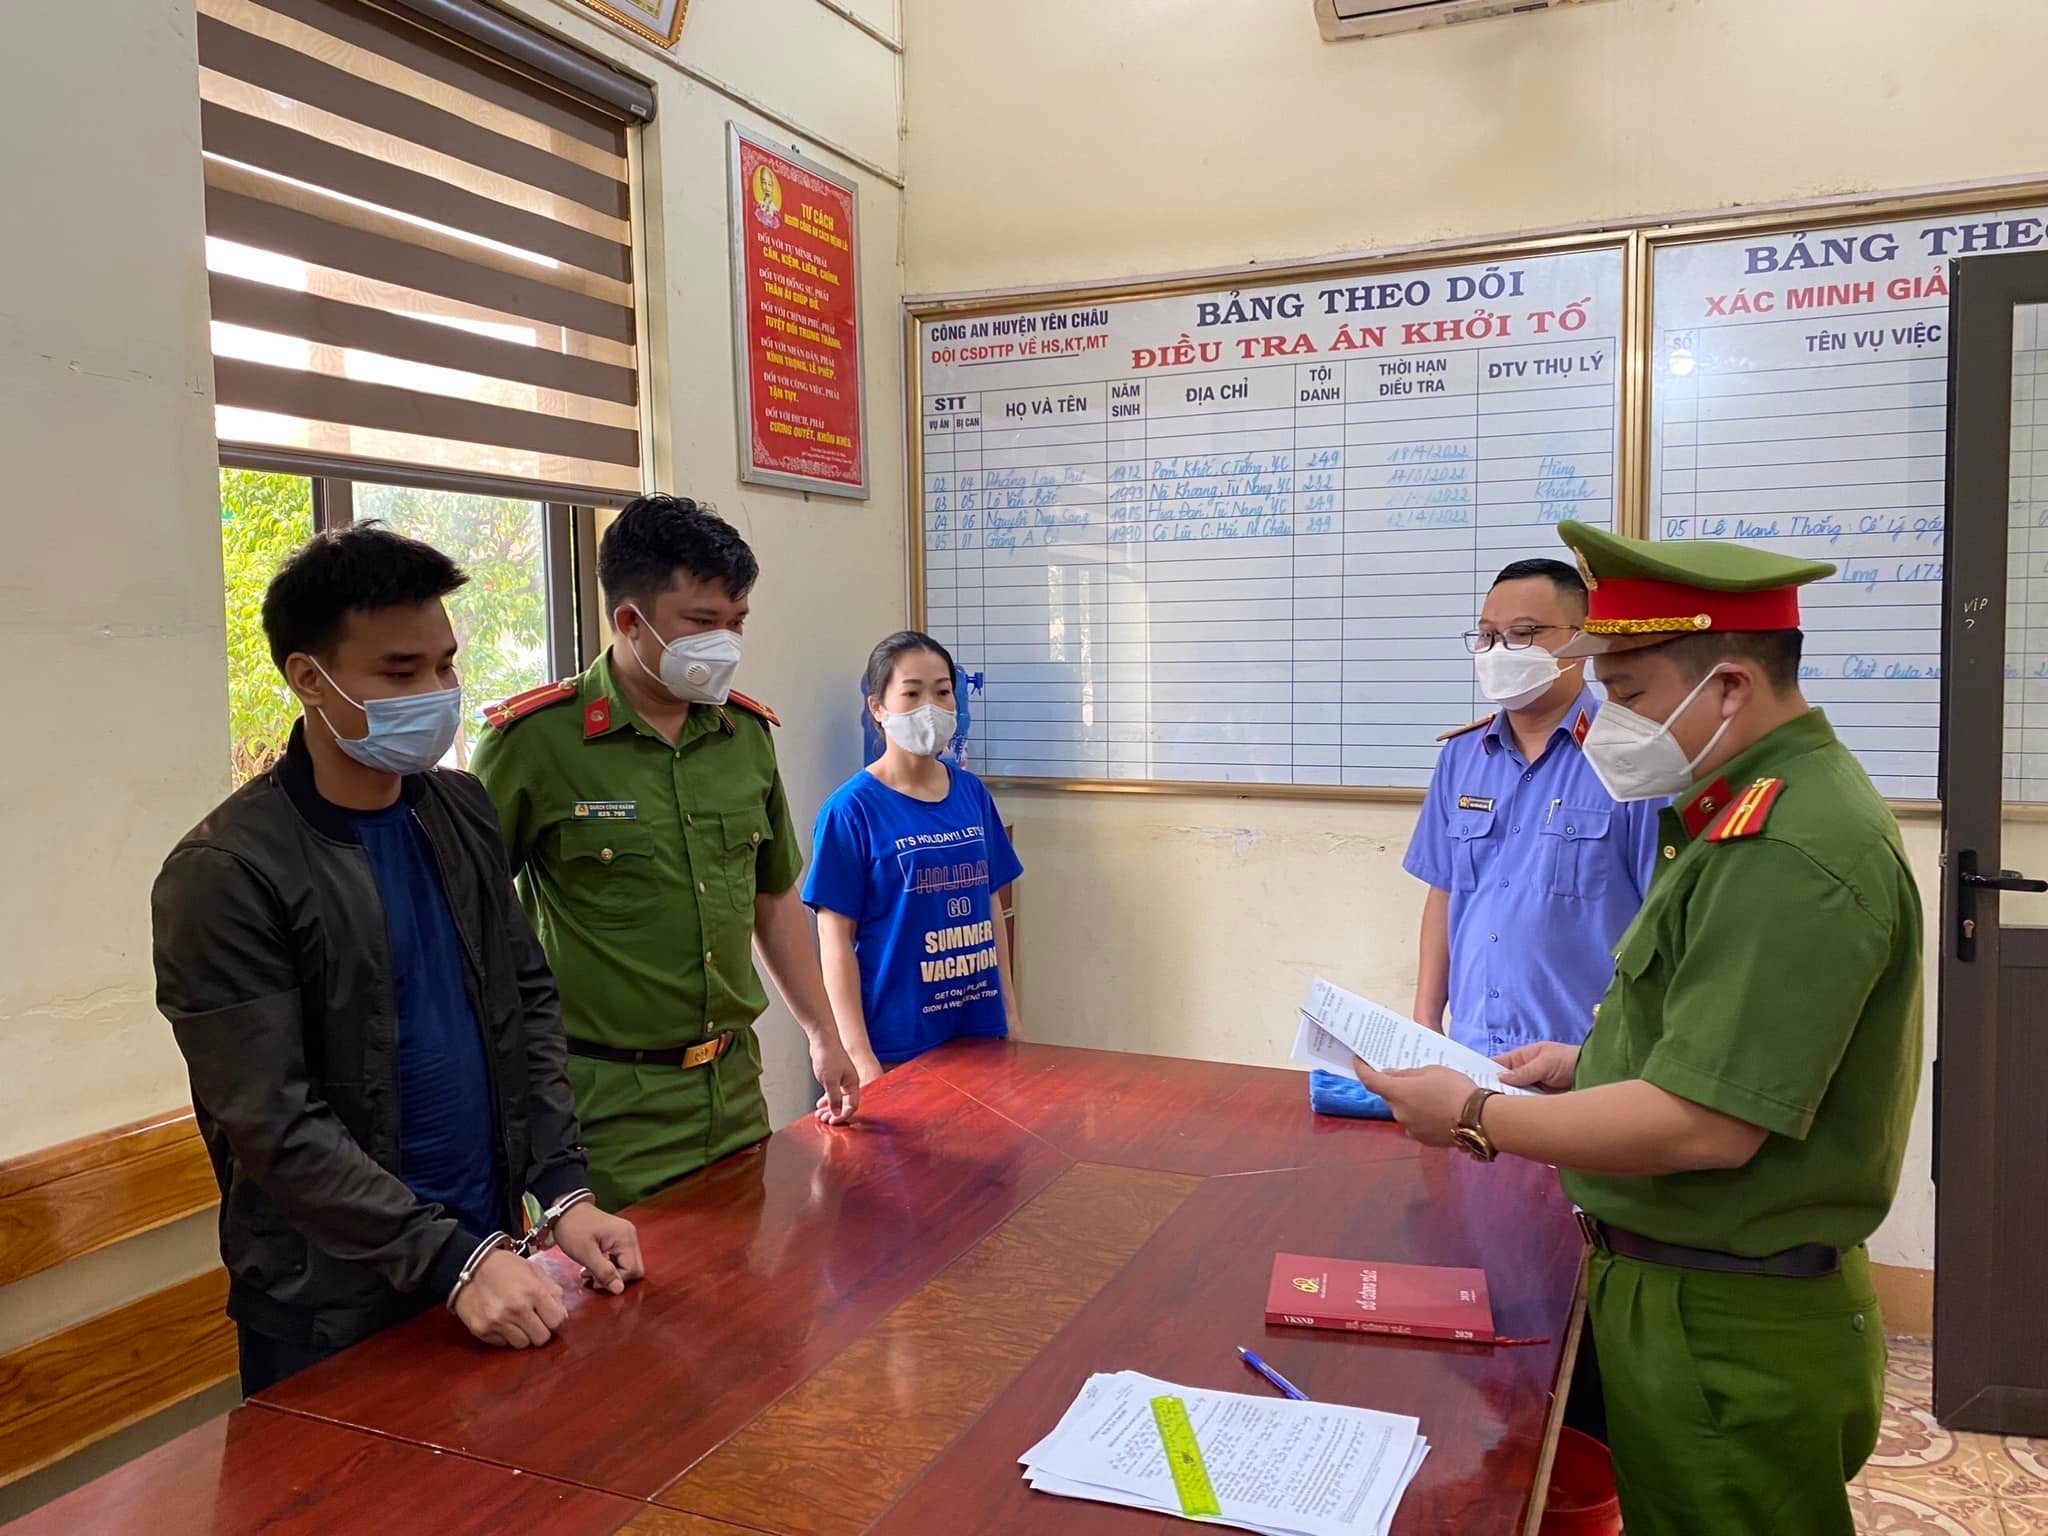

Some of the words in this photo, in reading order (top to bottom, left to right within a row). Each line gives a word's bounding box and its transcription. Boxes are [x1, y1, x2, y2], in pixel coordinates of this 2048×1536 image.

[814, 208, 834, 232] CÁCH
[758, 232, 770, 246] ĐỐI
[772, 237, 784, 250] VỚI
[1743, 231, 1899, 276] BẢNG
[1920, 218, 2048, 257] THE
[759, 267, 772, 281] ĐỐI
[774, 273, 786, 286] VỚI
[765, 282, 783, 298] THÂN
[1197, 290, 1304, 327] BẢNG
[1318, 280, 1431, 315] THEO
[1447, 266, 1525, 302] DÕI
[1704, 286, 1775, 318] XÁC
[1786, 281, 1875, 311] MINH
[760, 302, 773, 313] ĐỐI
[774, 306, 786, 318] VỚI
[766, 315, 784, 332] TUYỆT
[931, 321, 966, 342] CÔNG
[970, 321, 988, 338] AN
[992, 317, 1036, 339] HUYỆN
[1041, 313, 1068, 330] YÊN
[1071, 308, 1109, 328] CHÂU
[1131, 333, 1223, 370] ĐIỀU
[1236, 332, 1318, 360] TRA
[1329, 322, 1386, 351] ÁN
[1401, 309, 1511, 345] KHỞI
[1527, 297, 1591, 333] TỐ
[1805, 330, 1847, 353] TÊN
[1854, 328, 1885, 354] VỤ
[1890, 322, 1943, 348] VIỆC
[761, 337, 774, 348] ĐỐI
[774, 341, 786, 352] VỚI
[931, 348, 956, 368] ĐỘI
[960, 343, 1014, 361] CSĐTTP
[1018, 335, 1037, 355] VỀ
[1041, 334, 1109, 354] HS,KT,MT
[1309, 366, 1332, 383] TỘI
[1379, 358, 1414, 376] THỜI
[1416, 358, 1447, 379] HẠN
[1488, 360, 1526, 379] ĐTV
[1534, 357, 1572, 380] THỤ
[1579, 350, 1604, 371] LÝ
[764, 372, 776, 384] ĐỐI
[778, 375, 789, 387] VỚI
[790, 378, 810, 392] CÔNG
[1112, 384, 1140, 399] NĂM
[1186, 386, 1215, 406] ĐỊA
[1220, 376, 1248, 400] CHỈ
[1379, 378, 1414, 397] ĐIỀU
[1416, 378, 1446, 394] TRA
[1300, 386, 1340, 402] DANH
[934, 396, 967, 412] STT
[1006, 402, 1027, 421] HỌ
[1032, 396, 1054, 416] VÀ
[1058, 395, 1087, 412] TÊN
[1112, 403, 1140, 418] SINH
[765, 407, 778, 418] ĐỐI
[780, 410, 791, 422] VỚI
[929, 419, 940, 432] VỤ
[940, 416, 950, 430] ÁN
[956, 418, 964, 430] BỊ
[964, 416, 980, 428] CAN
[1667, 519, 1688, 538] 05
[896, 836, 917, 850] IT'S
[916, 831, 961, 845] HOLIDAY!!
[947, 896, 971, 918] GO
[924, 920, 994, 954] SUMMER
[920, 948, 998, 983] VACATION
[934, 990, 950, 1000] GET
[981, 989, 998, 998] TRIP
